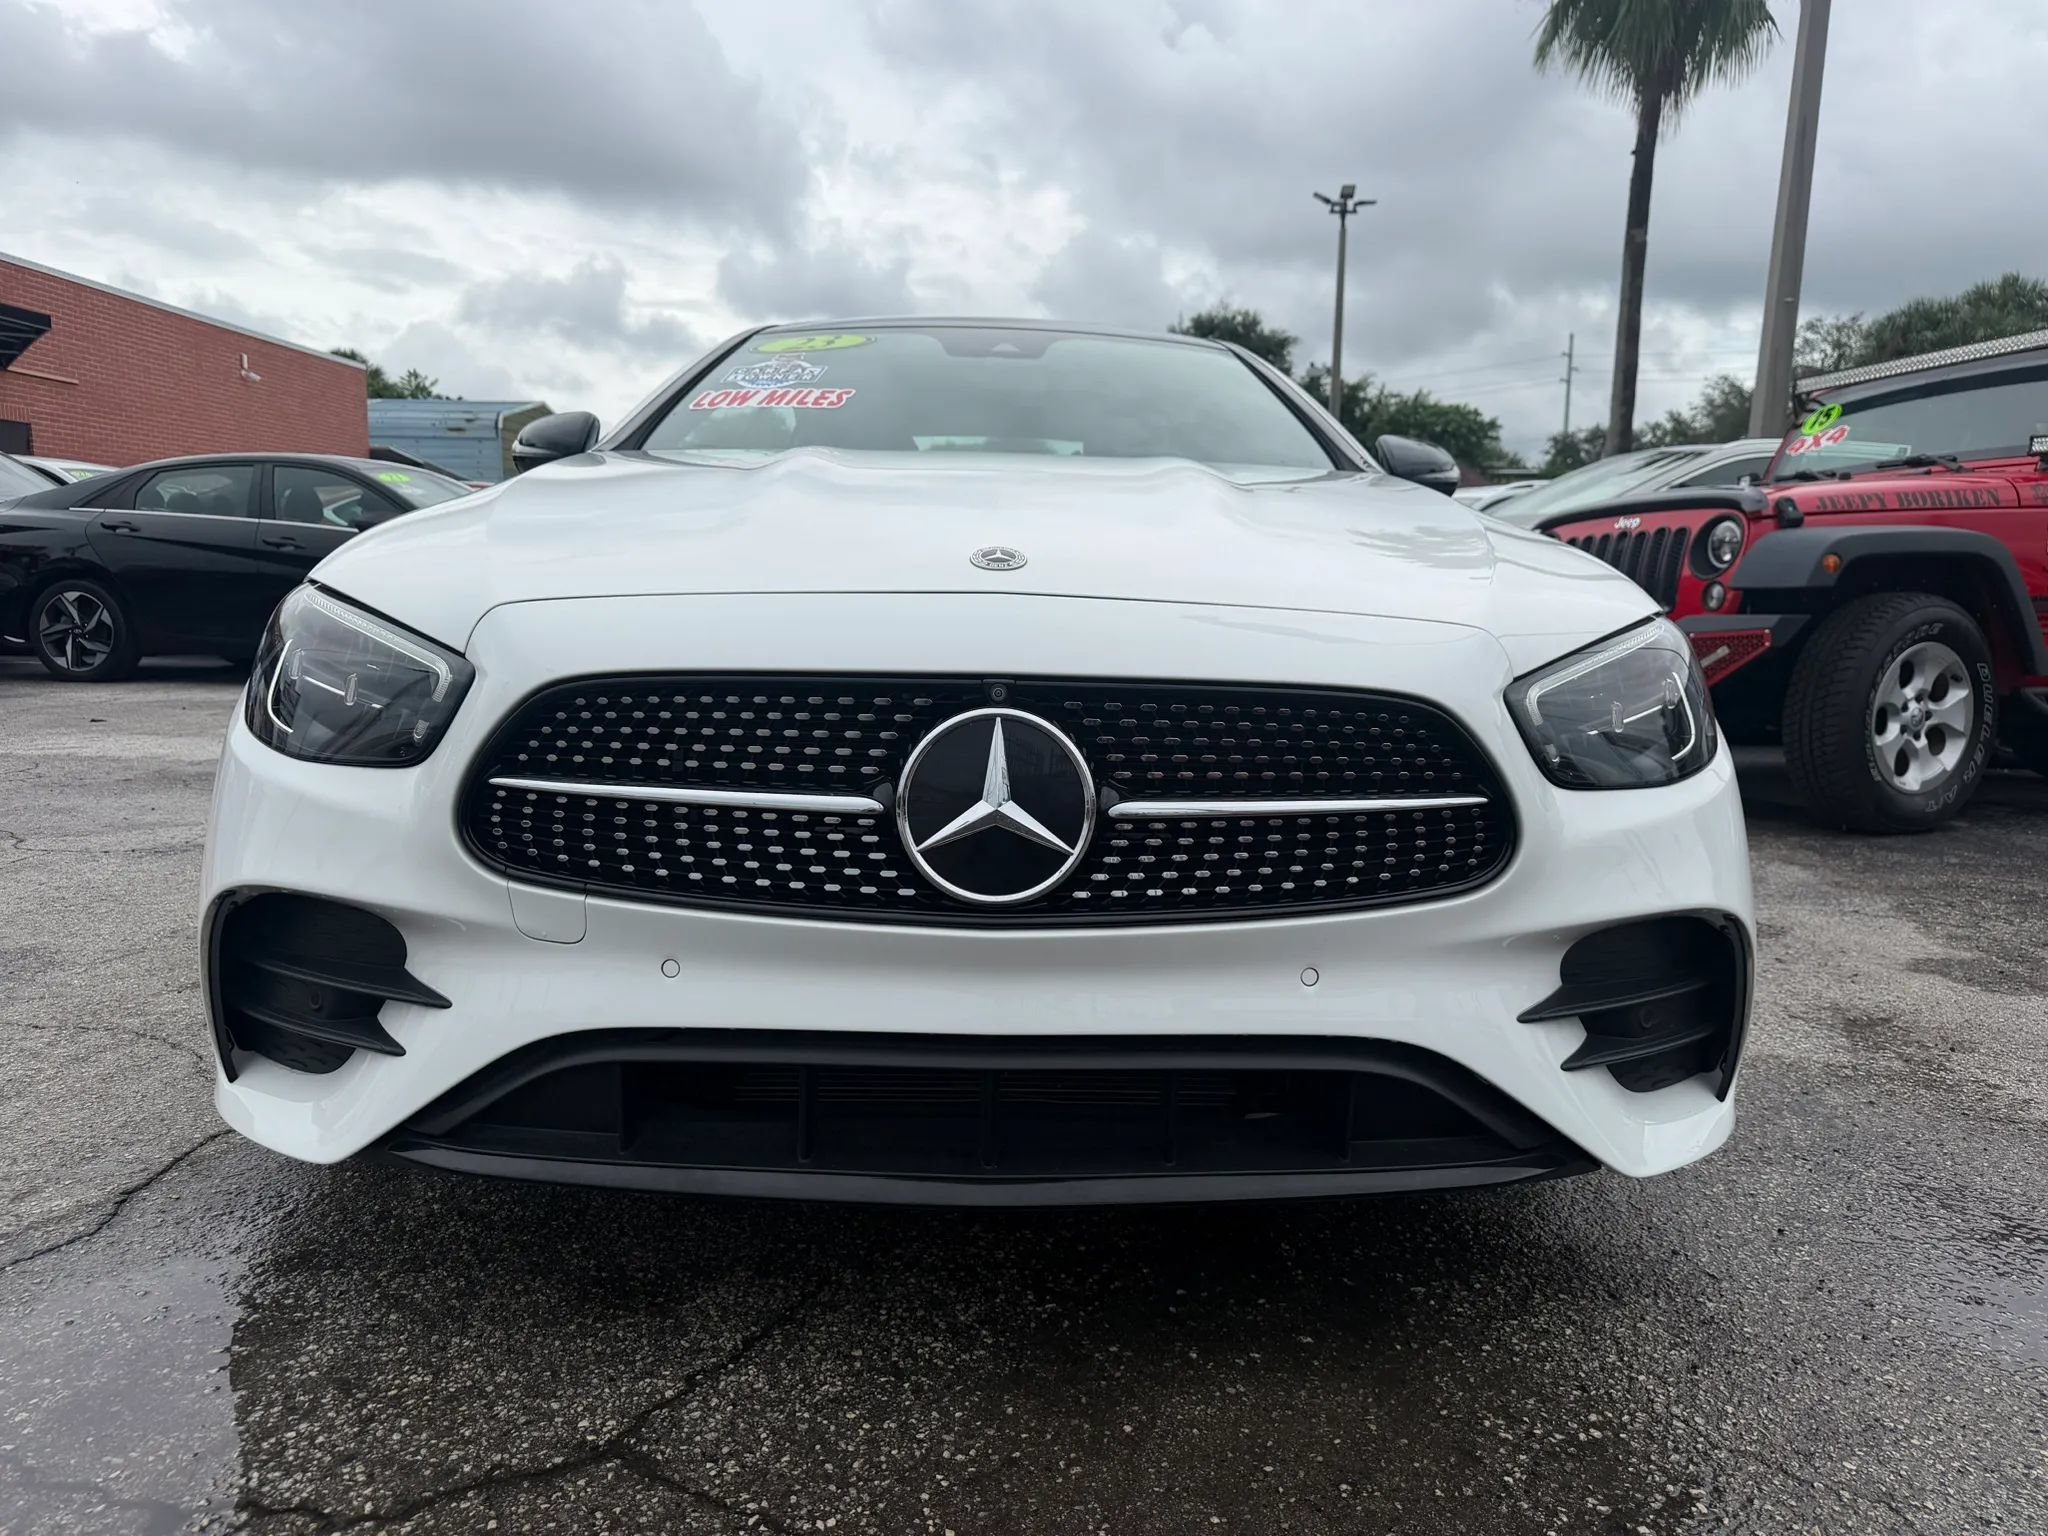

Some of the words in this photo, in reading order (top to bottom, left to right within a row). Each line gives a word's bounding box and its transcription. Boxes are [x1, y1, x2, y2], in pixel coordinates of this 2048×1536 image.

[692, 390, 761, 408] LOW
[756, 389, 854, 407] MILES
[1809, 406, 1836, 430] 15
[1816, 492, 1887, 511] JEEPY
[1895, 487, 2001, 509] BORIKEN
[1613, 515, 1641, 530] Jeep
